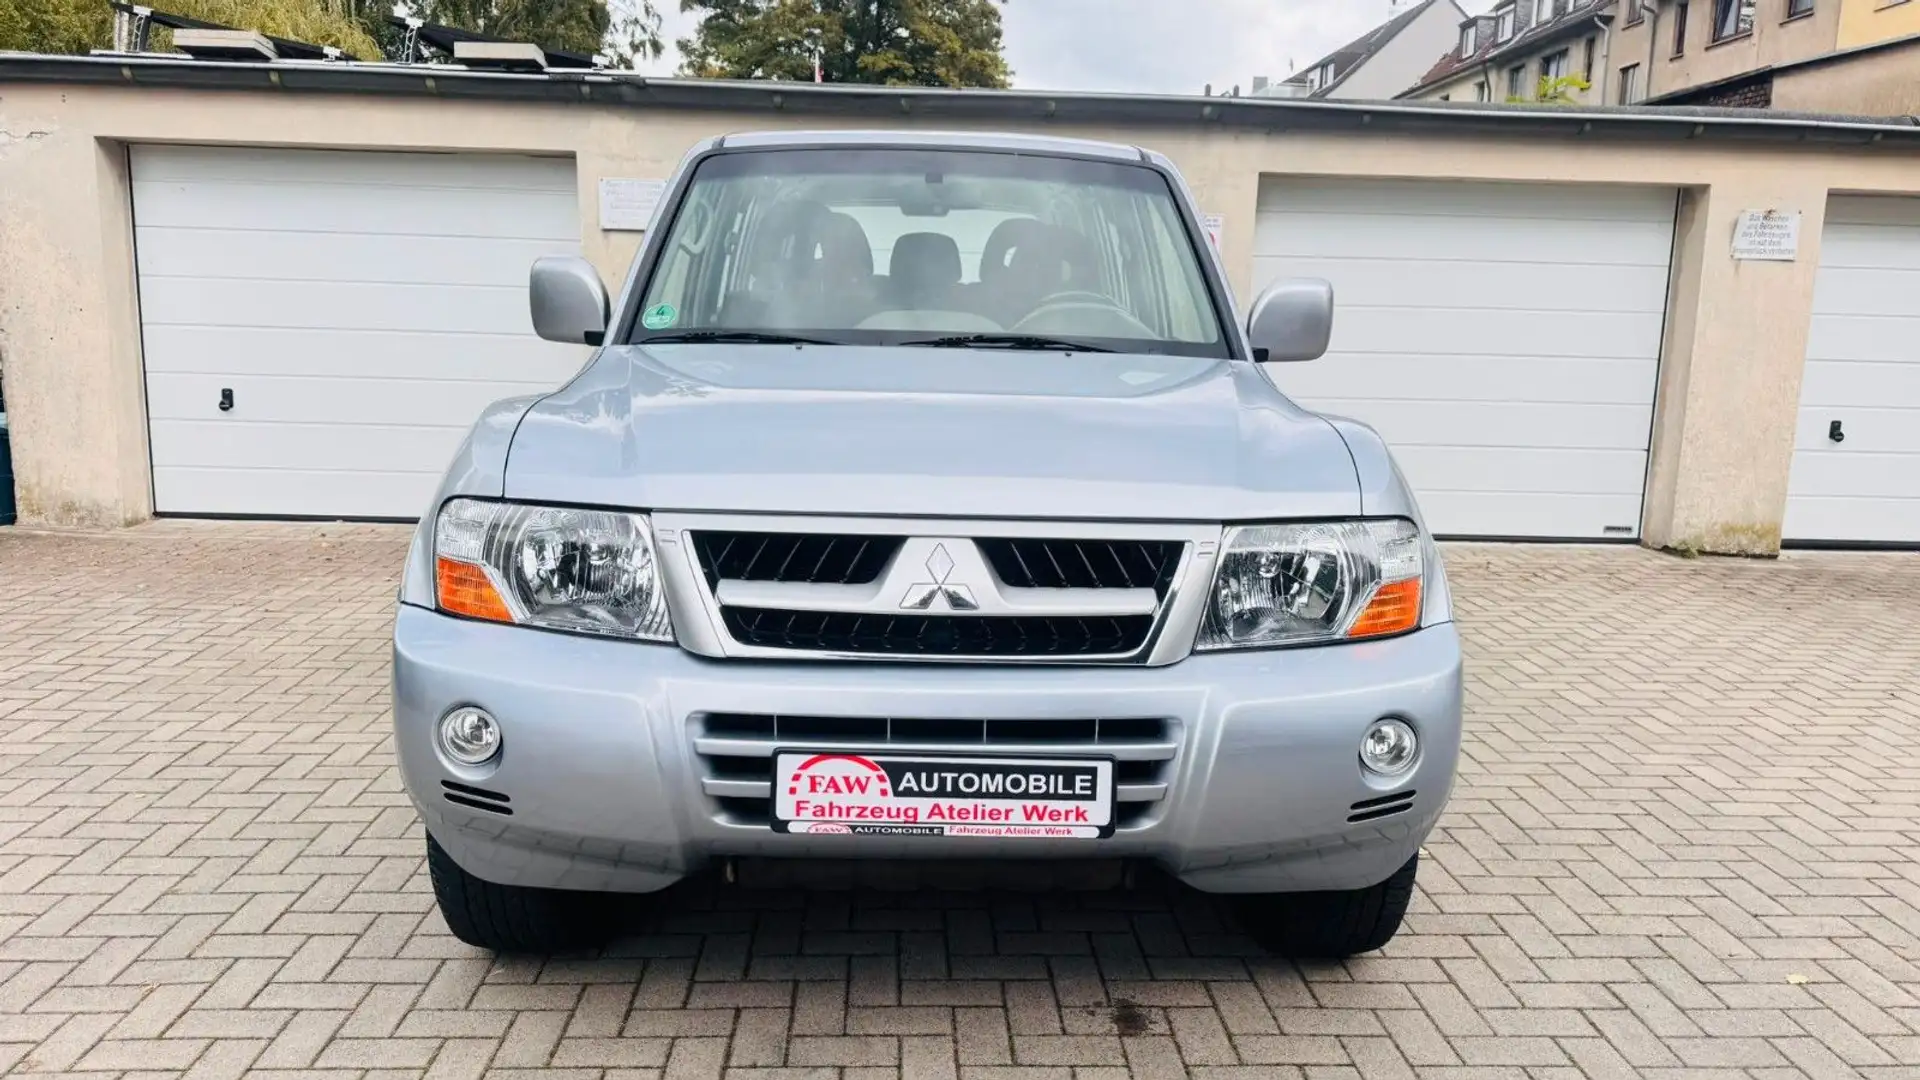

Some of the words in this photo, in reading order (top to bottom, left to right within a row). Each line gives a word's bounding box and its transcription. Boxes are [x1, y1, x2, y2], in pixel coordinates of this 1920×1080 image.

[1749, 213, 1761, 222] Das
[656, 305, 665, 316] 4
[807, 774, 872, 795] FAW
[898, 771, 1092, 795] AUTOMOBILE
[795, 800, 918, 824] Fahrzeug
[926, 803, 1014, 821] Atelier
[1022, 804, 1088, 822] Werk
[814, 826, 844, 834] FAW
[855, 826, 942, 835] AUTOMOBILE
[949, 825, 1001, 835] Fahrzeug
[1004, 826, 1041, 835] Atelier
[1045, 827, 1073, 836] Werk
